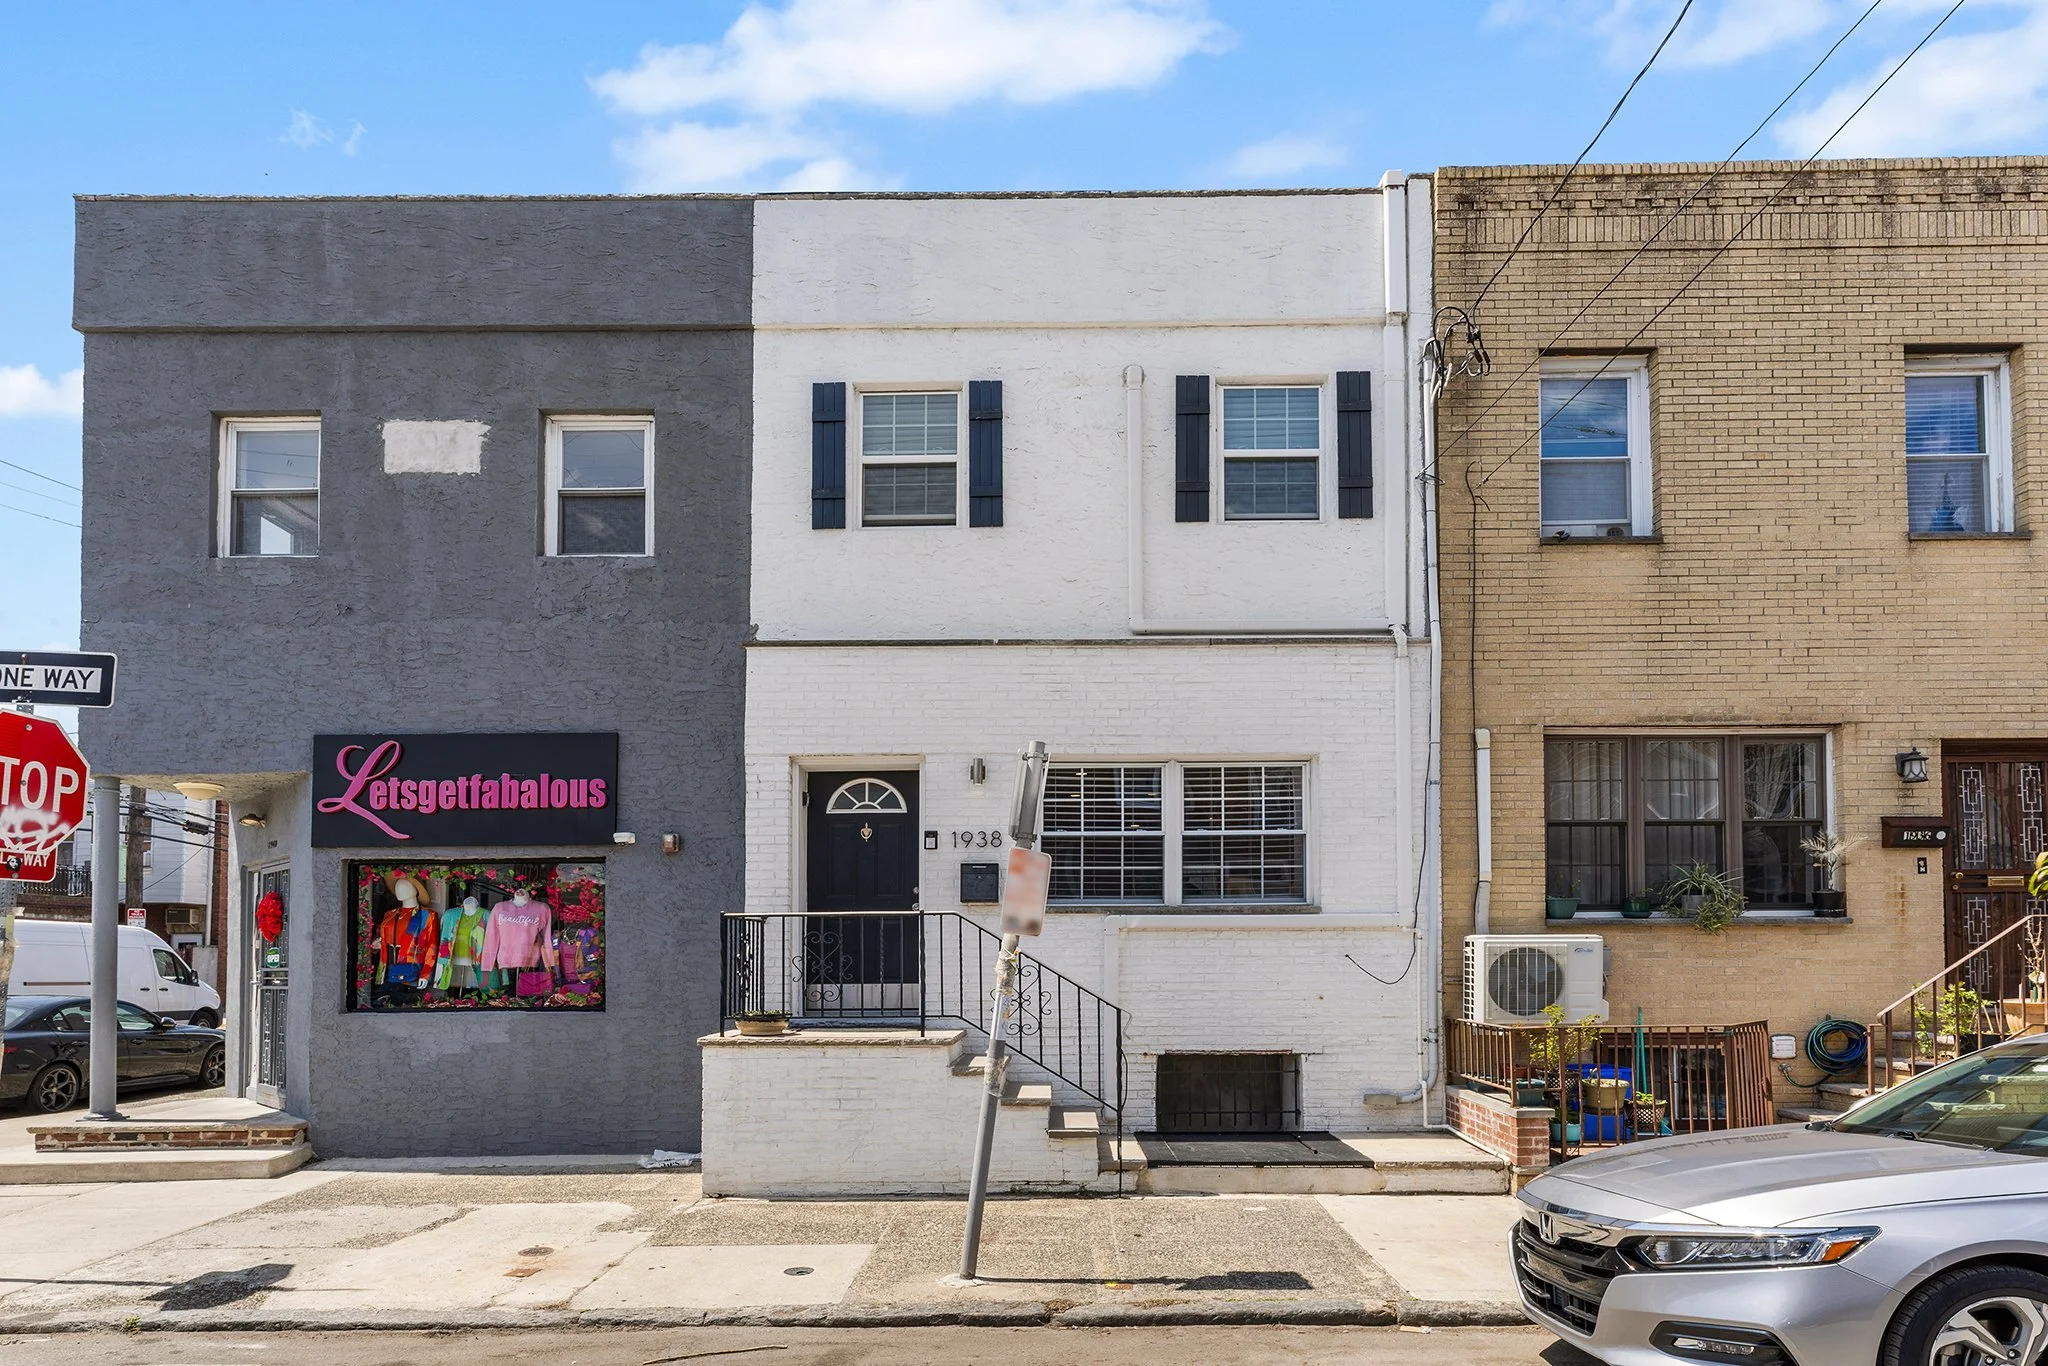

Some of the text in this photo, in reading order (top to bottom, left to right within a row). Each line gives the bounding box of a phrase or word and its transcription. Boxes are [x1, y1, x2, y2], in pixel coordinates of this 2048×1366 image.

[0, 667, 95, 690] NE WAY
[0, 755, 79, 813] TOP
[317, 740, 608, 840] Letsgetfabalous
[951, 830, 1003, 849] 1938
